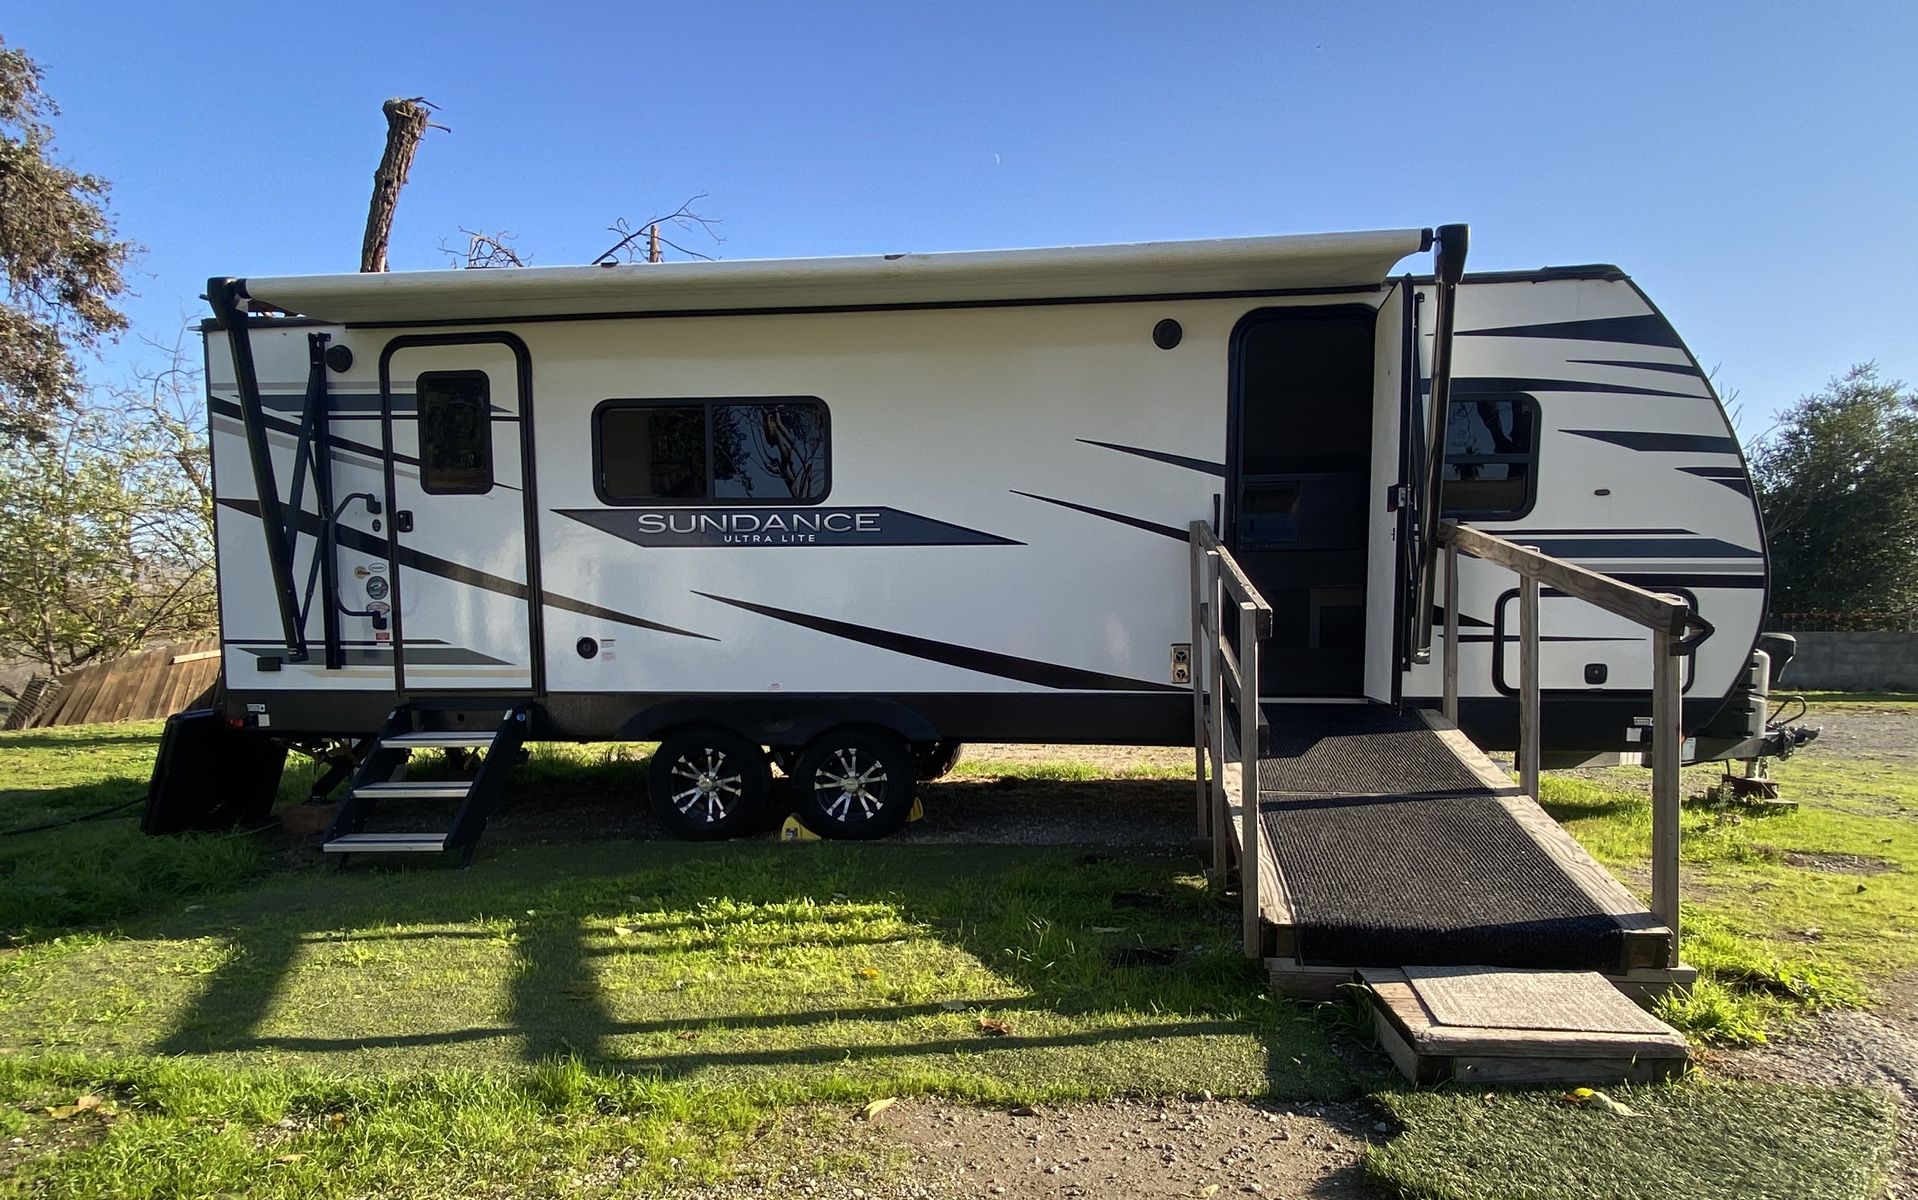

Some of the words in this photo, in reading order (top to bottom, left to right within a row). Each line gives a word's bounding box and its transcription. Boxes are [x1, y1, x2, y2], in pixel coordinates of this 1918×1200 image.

[638, 512, 882, 534] SUNDANCE
[723, 534, 773, 543] ULTRA
[781, 534, 816, 543] LITE
